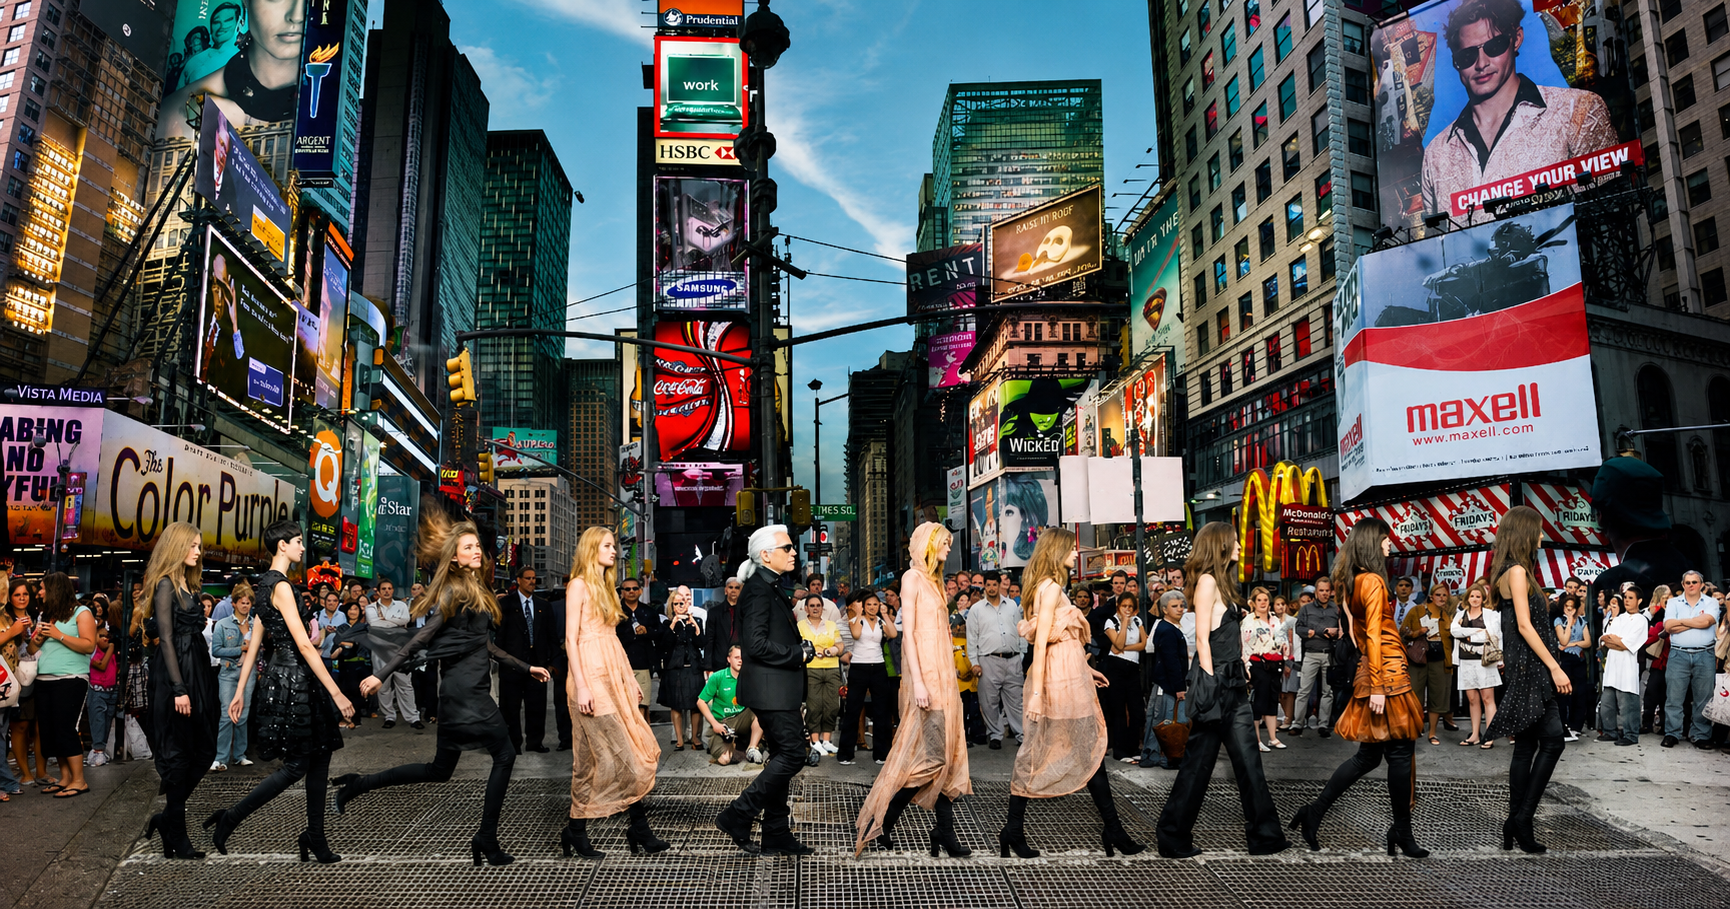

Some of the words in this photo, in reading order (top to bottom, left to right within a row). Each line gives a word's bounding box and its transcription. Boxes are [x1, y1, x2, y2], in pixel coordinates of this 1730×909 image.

[686, 15, 738, 25] Prudential
[683, 79, 719, 91] work
[296, 136, 331, 145] ARGENT
[660, 145, 710, 159] HSBC
[1458, 178, 1524, 210] CHANGE
[1528, 164, 1575, 188] YOUR
[1581, 147, 1629, 173] VIEW
[909, 256, 975, 292] RENT
[59, 387, 103, 403] MEDIA
[1406, 382, 1541, 433] maxell
[1412, 423, 1534, 446] www.maxell.com
[110, 446, 211, 543] Color
[216, 470, 288, 548] Purple
